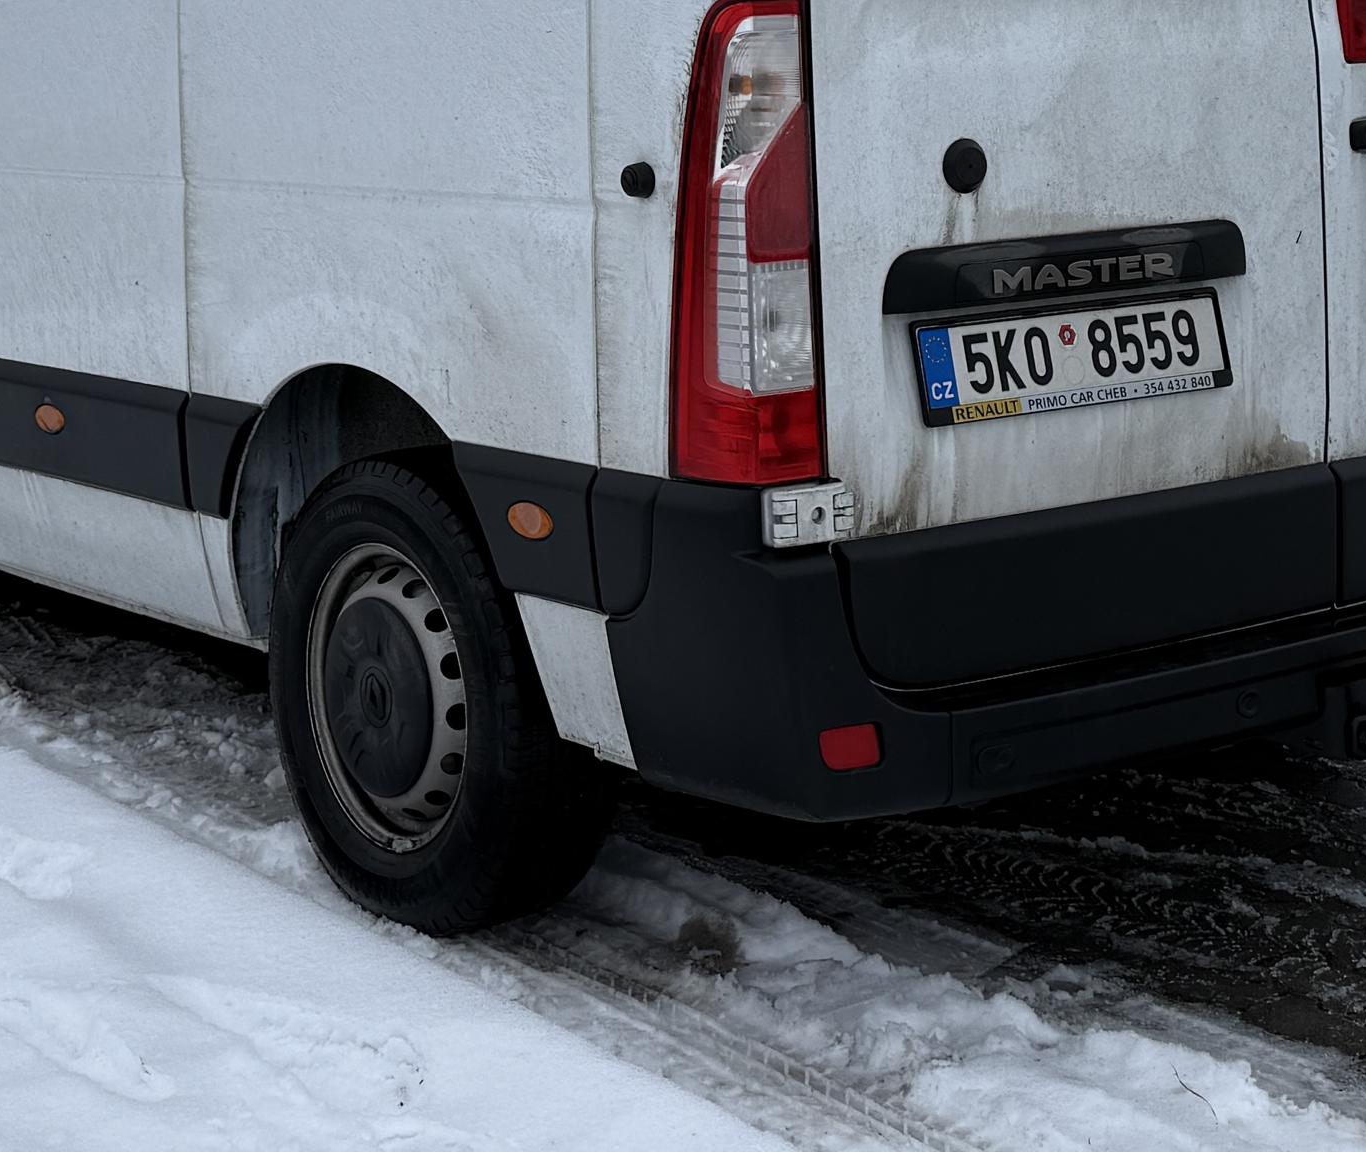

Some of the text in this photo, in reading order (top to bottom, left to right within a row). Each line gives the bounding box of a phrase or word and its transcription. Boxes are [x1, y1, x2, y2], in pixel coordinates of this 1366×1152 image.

[992, 252, 1175, 295] MASTER
[961, 309, 1201, 395] 5K0 8559
[931, 380, 955, 402] CZ
[955, 375, 1212, 423] RENAULT PRIMO CAR CHEB 354 432 840
